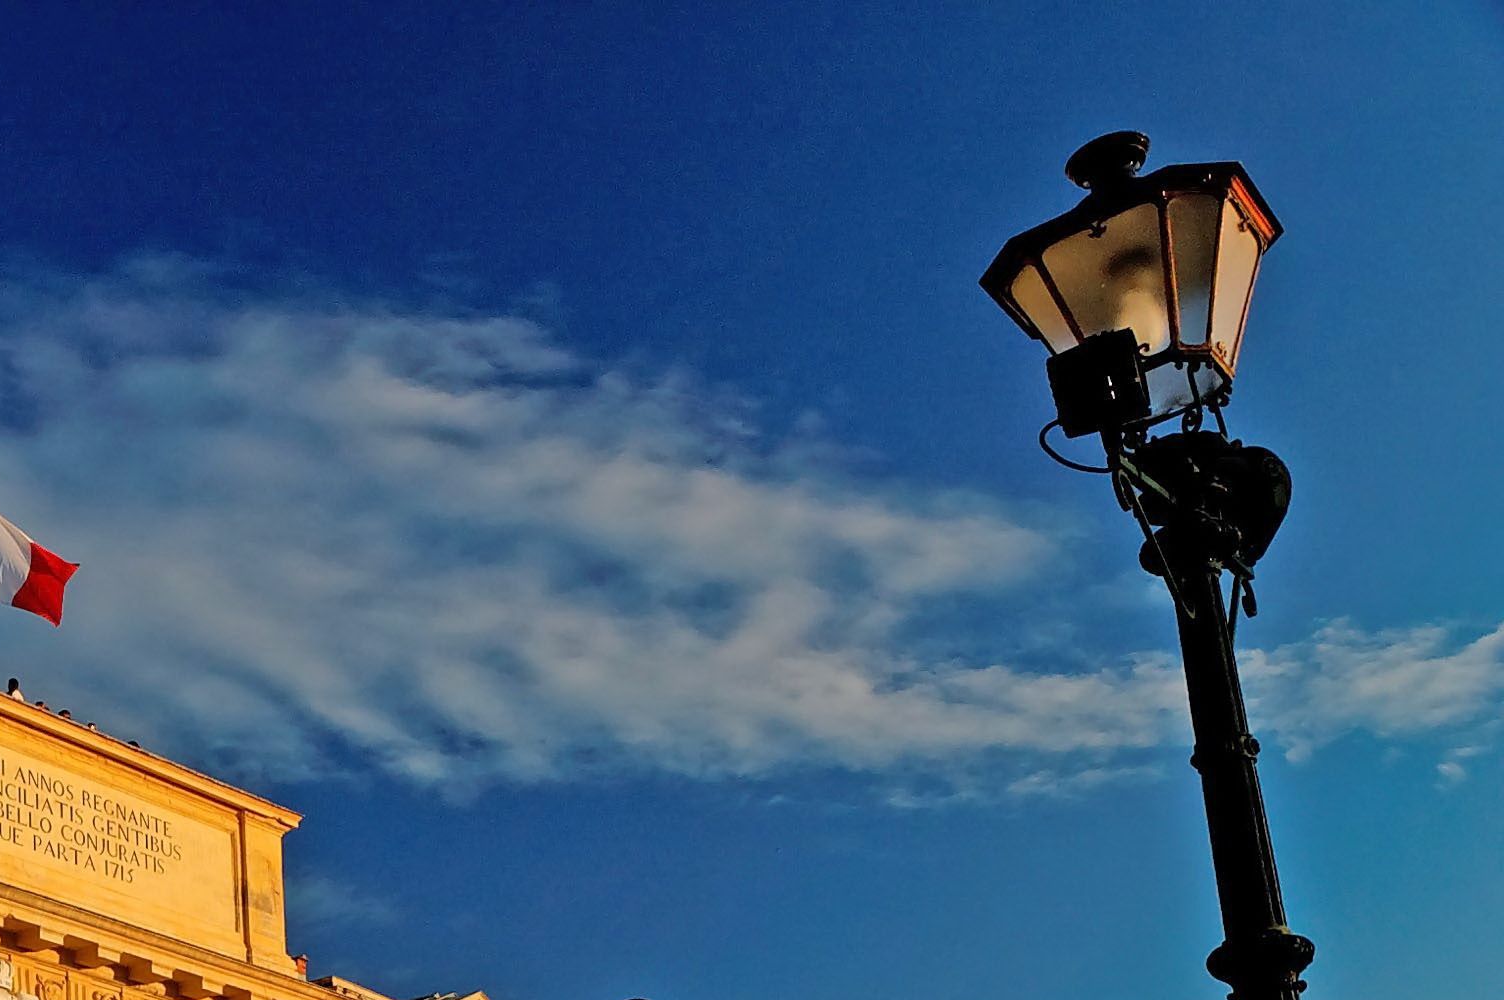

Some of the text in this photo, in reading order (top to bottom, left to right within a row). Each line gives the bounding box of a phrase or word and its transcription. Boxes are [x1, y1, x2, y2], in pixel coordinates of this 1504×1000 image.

[14, 766, 74, 801] ANNOS
[82, 790, 173, 838] REGNANTE
[33, 834, 96, 872] PARTA
[104, 859, 134, 884] 1715
[61, 824, 165, 874] CONJURATIS
[93, 815, 182, 861] GENTIBUS
